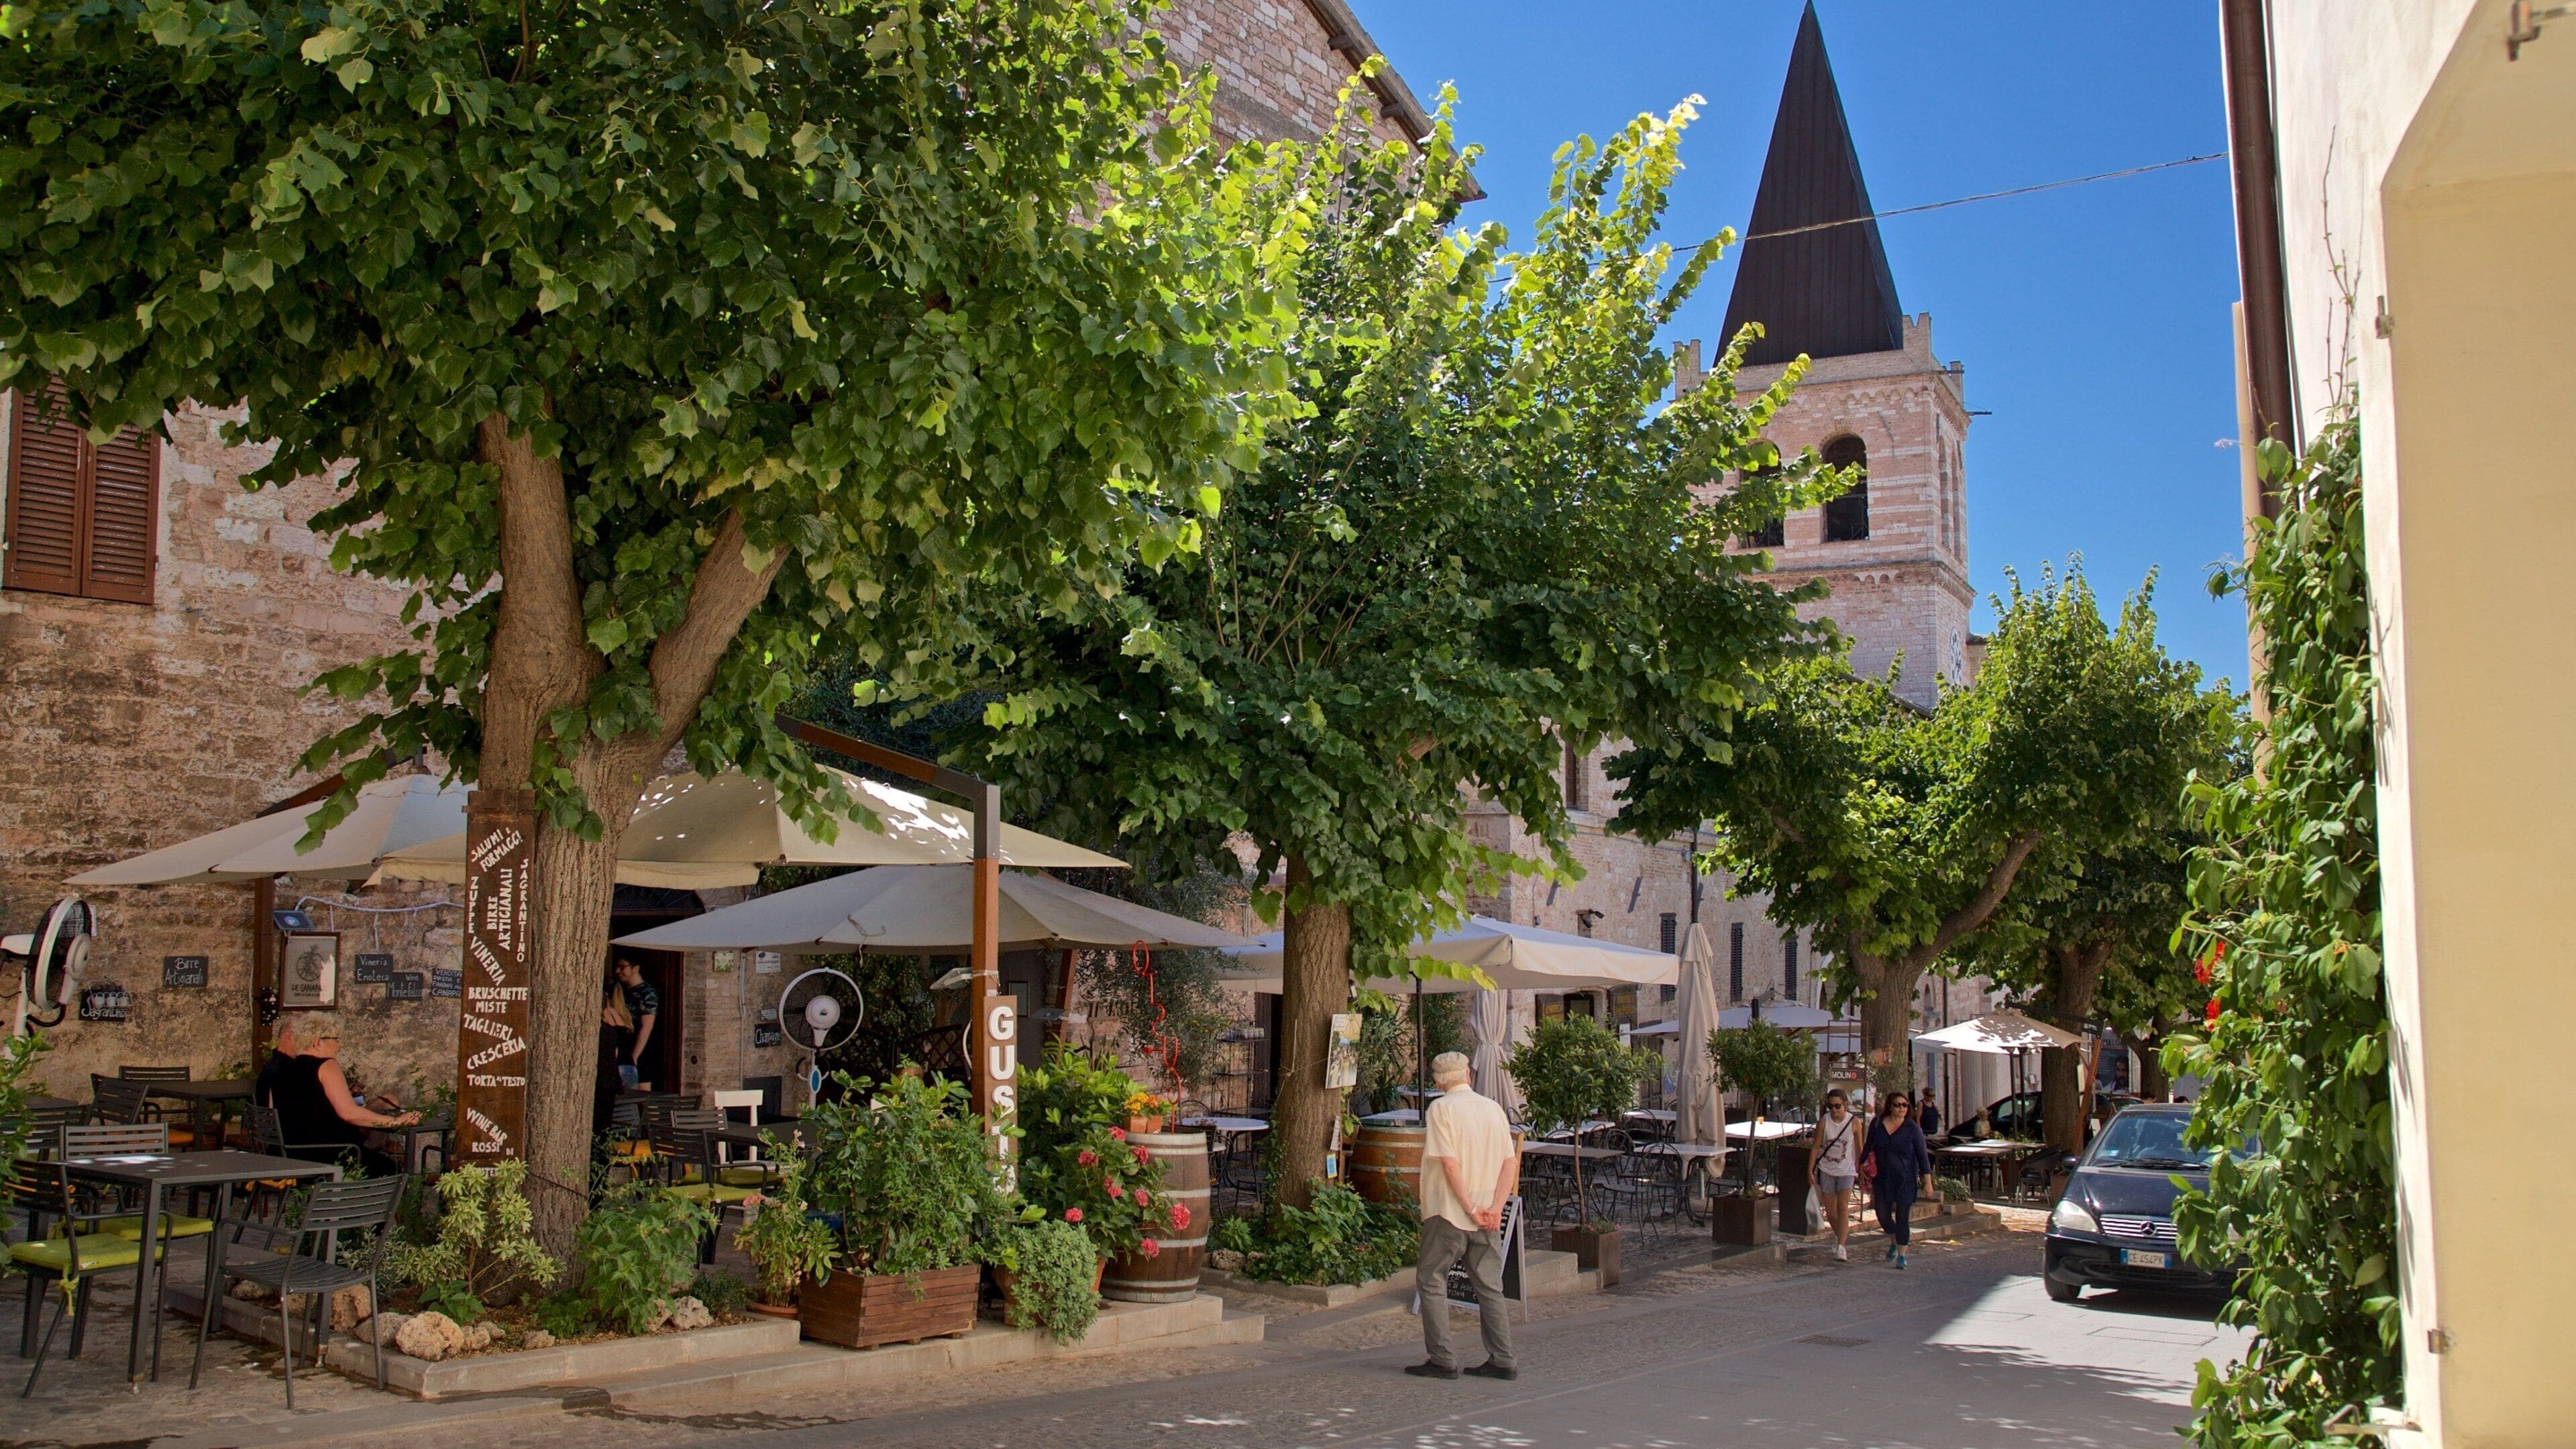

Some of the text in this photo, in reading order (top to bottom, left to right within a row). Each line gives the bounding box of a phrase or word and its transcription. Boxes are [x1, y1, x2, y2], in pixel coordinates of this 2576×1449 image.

[472, 829, 504, 863] SALUMI
[468, 876, 478, 933] ZUPPE
[487, 896, 497, 930] BIRRE
[498, 868, 512, 951] ARTIGIANALI
[517, 859, 529, 962] SAGRANTINO
[470, 936, 506, 986] VINERIA
[468, 987, 528, 1001] BRUSCHETTE
[476, 1002, 507, 1014] MISTE
[464, 1014, 513, 1041] TAGLIERI
[467, 1036, 526, 1069] CRESCERIA
[467, 1074, 496, 1087] TORTA
[502, 1076, 525, 1087] TESTO
[467, 1108, 508, 1146] WINE BAR
[472, 1142, 500, 1153] ROSSI
